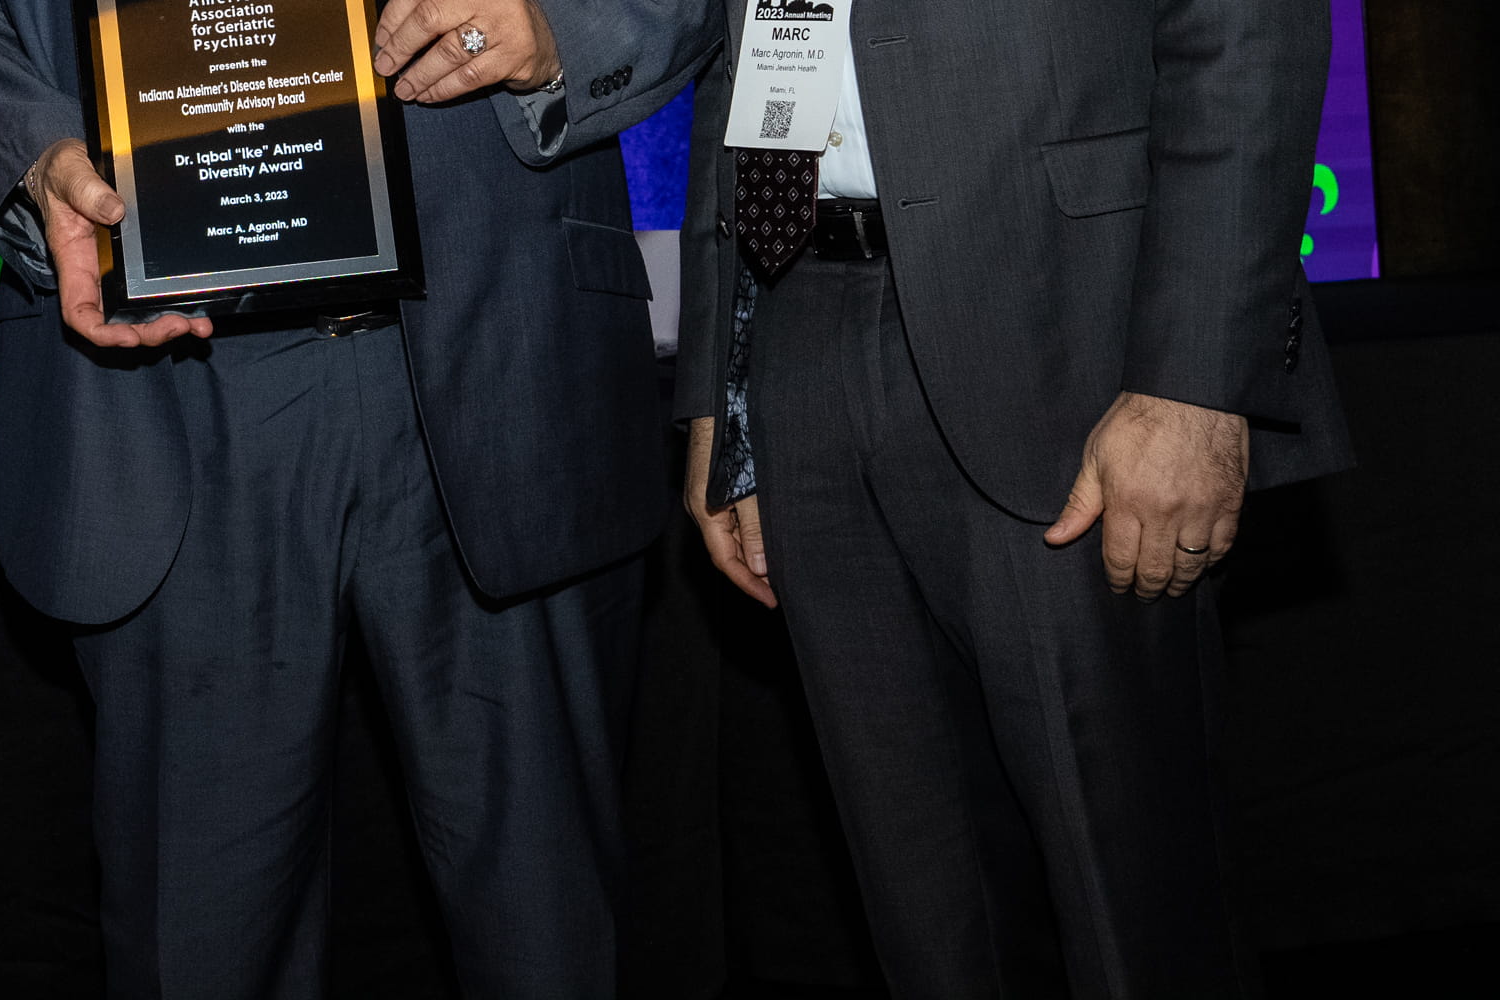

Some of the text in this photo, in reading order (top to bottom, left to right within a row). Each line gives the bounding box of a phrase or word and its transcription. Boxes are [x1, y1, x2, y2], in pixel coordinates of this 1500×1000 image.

[190, 3, 274, 22] Association
[756, 7, 832, 20] 2023 Annual Meeting
[191, 16, 276, 37] for Geriatric
[772, 27, 810, 40] MARC
[193, 33, 276, 53] Psychiatry
[751, 48, 826, 60] Marc Agronin, M.D.
[209, 58, 267, 73] presents the
[757, 63, 774, 71] Miami
[775, 64, 796, 72] Jewish
[139, 70, 344, 103] Indiana Alzheimer's Disease Research Center
[181, 91, 305, 116] Community Advisory Board
[227, 122, 265, 134] with the
[175, 154, 194, 166] Dr.
[196, 149, 232, 166] Iqbal
[273, 139, 323, 156] Ahmed
[199, 157, 303, 180] Diversity Award
[220, 190, 288, 206] March 3, 2023
[207, 217, 308, 237] Marc A. Agronin, MD
[238, 232, 279, 244] President
